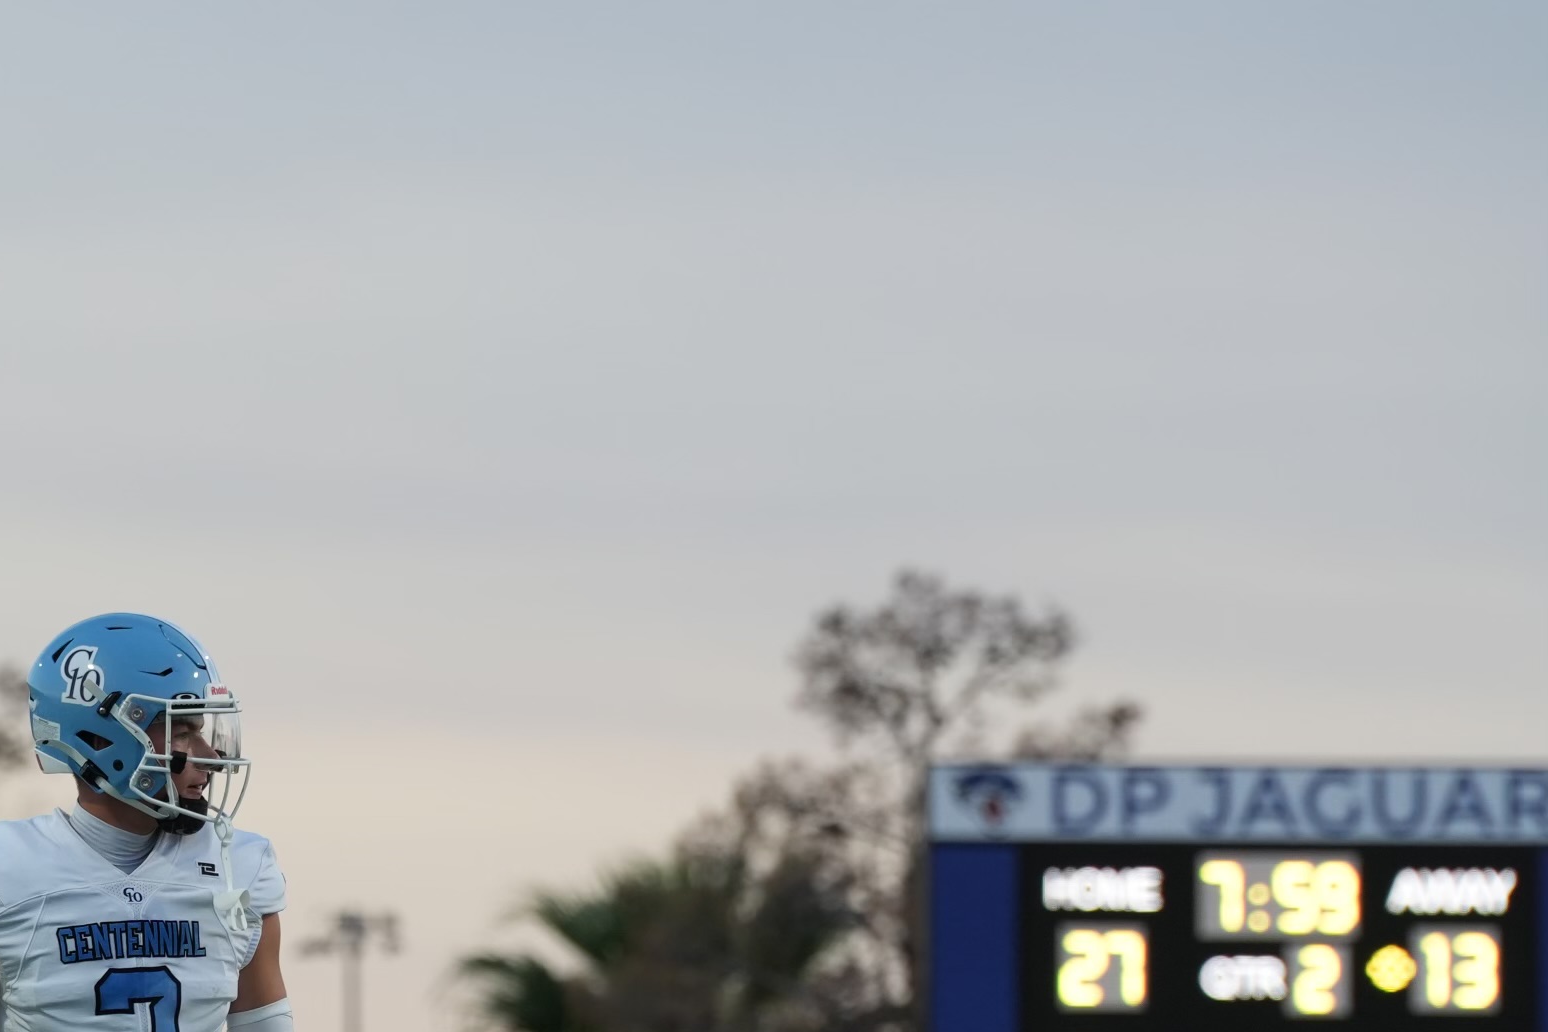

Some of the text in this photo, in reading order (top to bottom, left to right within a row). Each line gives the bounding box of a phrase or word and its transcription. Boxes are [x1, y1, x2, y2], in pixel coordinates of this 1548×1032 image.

[1053, 768, 1172, 838] DP
[1042, 866, 1165, 913] HOME
[1199, 860, 1361, 935] 7:59
[1385, 867, 1517, 915] AWAY
[55, 919, 207, 964] CENTENNIAL
[1057, 929, 1147, 1008] 27
[1420, 931, 1500, 1010] 13
[1198, 943, 1342, 1015] QTR 2
